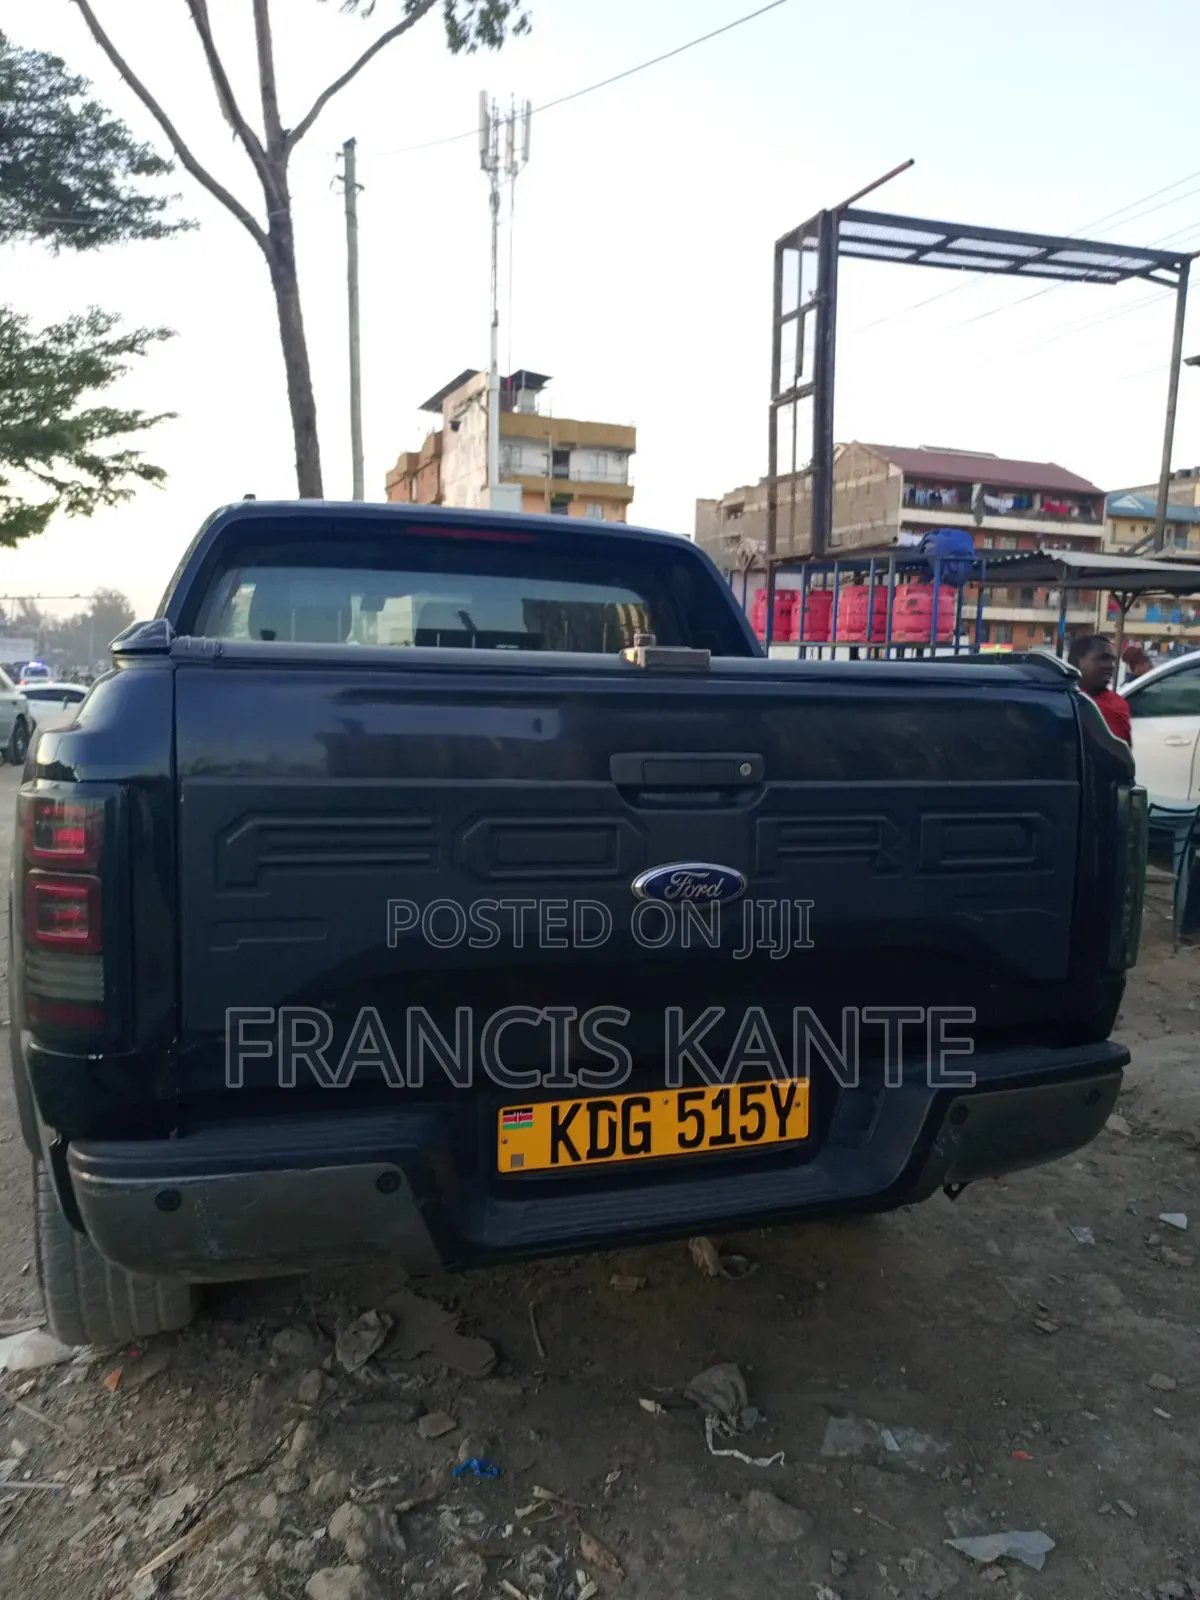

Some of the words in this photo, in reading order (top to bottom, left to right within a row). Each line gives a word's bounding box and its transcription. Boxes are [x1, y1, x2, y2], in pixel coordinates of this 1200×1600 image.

[664, 871, 725, 899] Ford
[550, 1097, 652, 1164] KDG
[677, 1083, 798, 1148] 515Y
